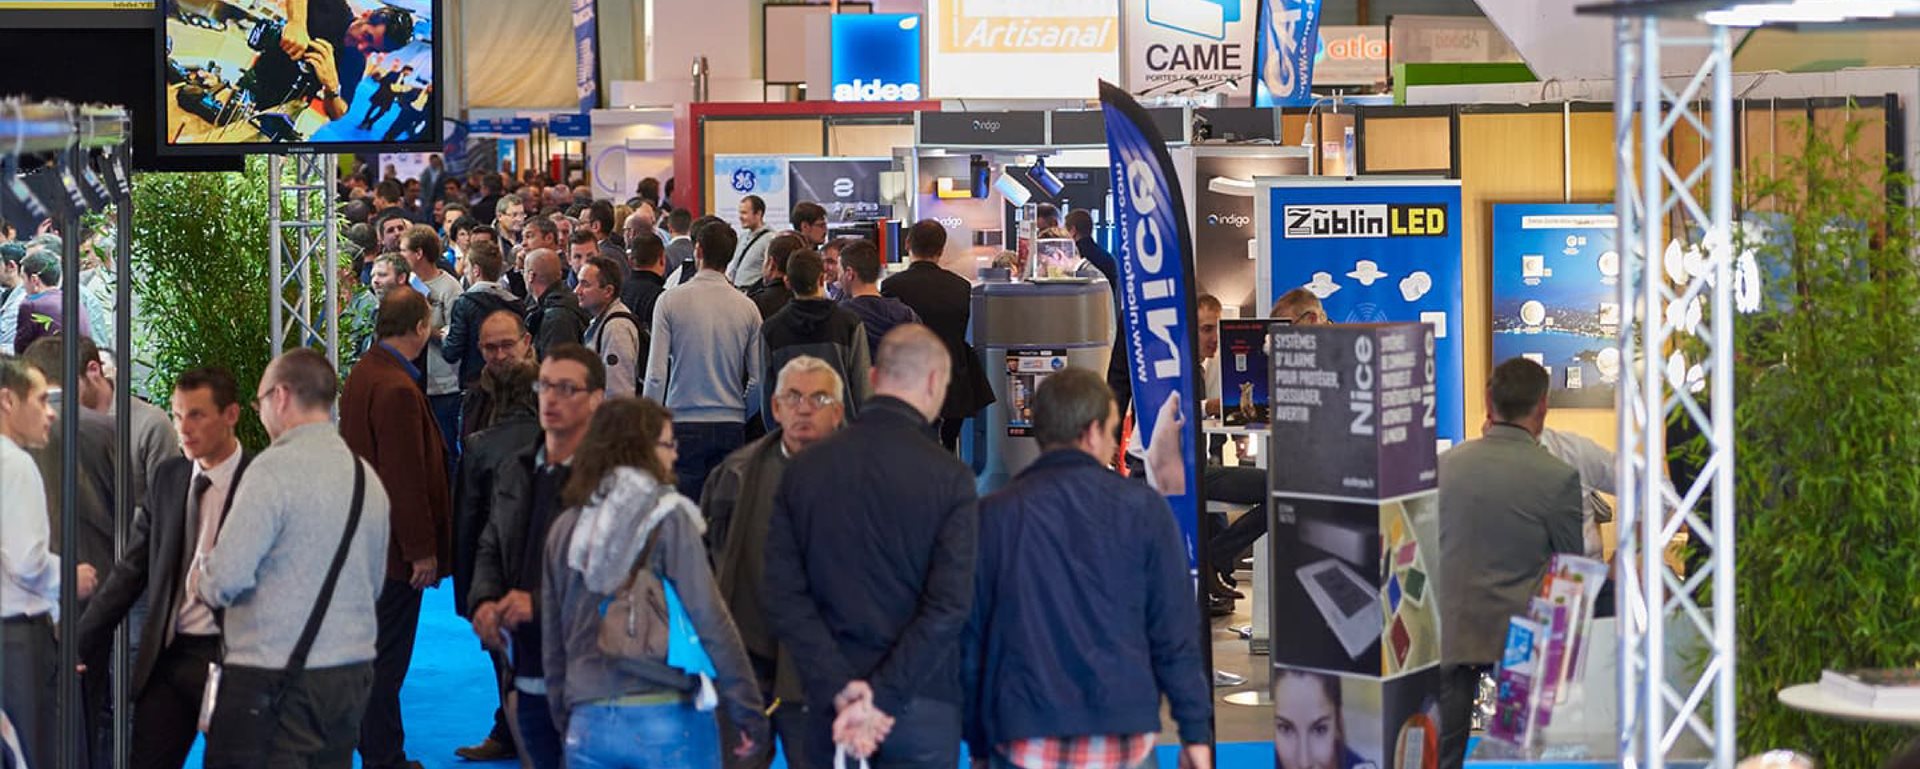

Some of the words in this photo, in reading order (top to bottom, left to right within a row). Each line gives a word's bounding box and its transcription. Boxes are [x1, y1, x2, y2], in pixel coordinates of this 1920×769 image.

[963, 19, 1112, 47] Artisanal
[1146, 44, 1241, 71] CAME
[1264, 0, 1301, 97] CA
[833, 79, 920, 101] aldes
[1219, 213, 1250, 228] indigo
[1391, 208, 1445, 234] LED
[1275, 331, 1316, 349] SYSTÈMES
[1350, 335, 1374, 435] Nice
[1423, 330, 1436, 428] Nice
